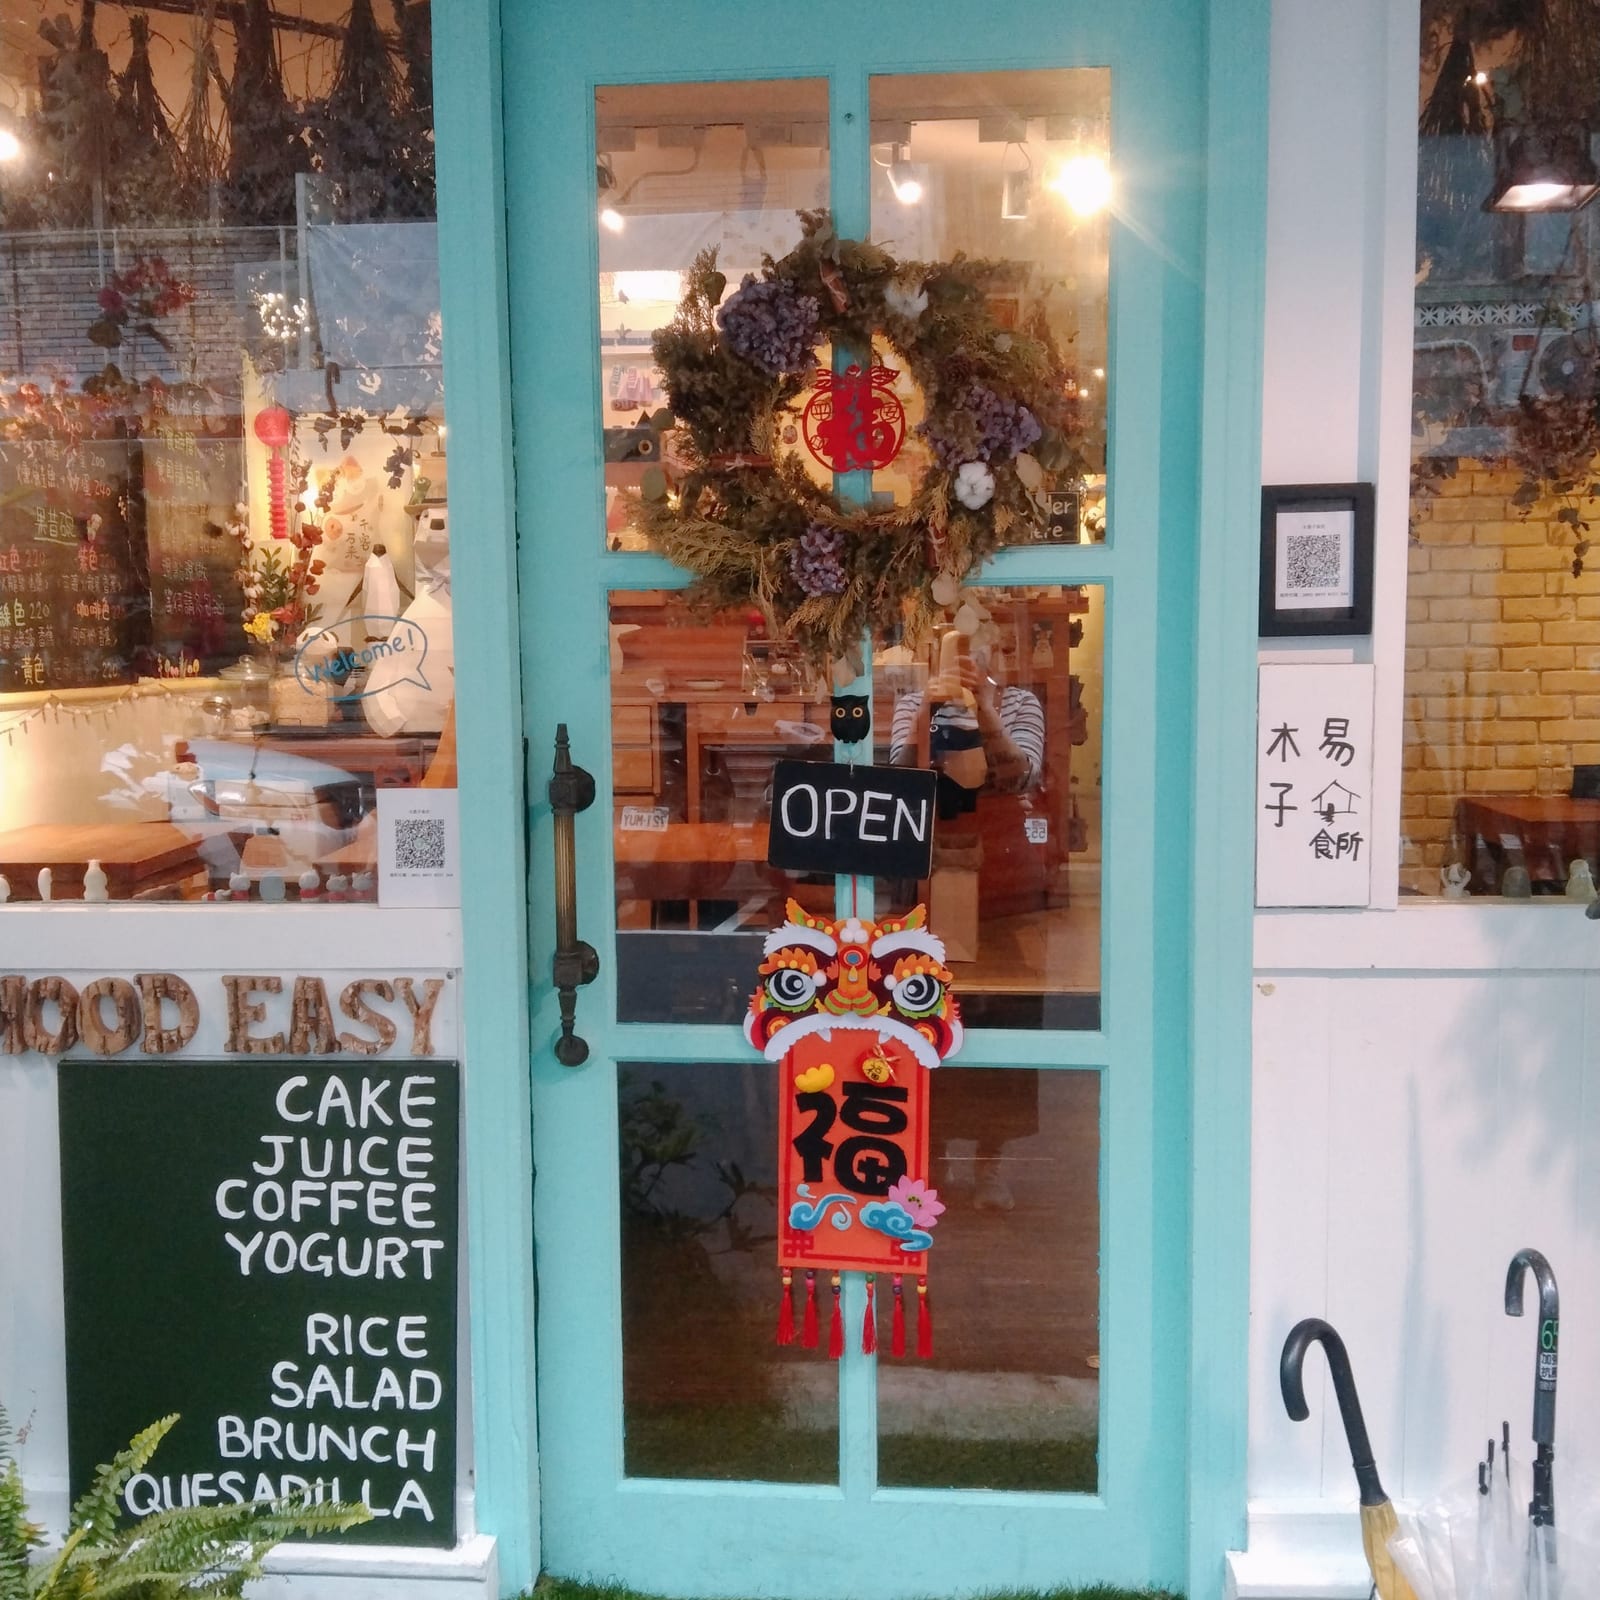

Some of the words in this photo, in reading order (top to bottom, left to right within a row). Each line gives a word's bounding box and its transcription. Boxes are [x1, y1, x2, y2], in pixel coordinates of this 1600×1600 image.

[30, 601, 50, 619] 220
[306, 628, 416, 683] Welcome!
[781, 784, 927, 842] OPEN
[221, 974, 445, 1056] EASY
[275, 1075, 436, 1129] CAKE
[252, 1135, 434, 1179] JUICE
[793, 1082, 908, 1196] 福
[215, 1179, 436, 1229] COFFEE
[224, 1231, 445, 1280] YOGURT
[306, 1312, 428, 1359] RICE
[270, 1360, 442, 1412] SALAD
[217, 1415, 436, 1473] BRUNCH
[124, 1471, 435, 1522] QUESADILLA
